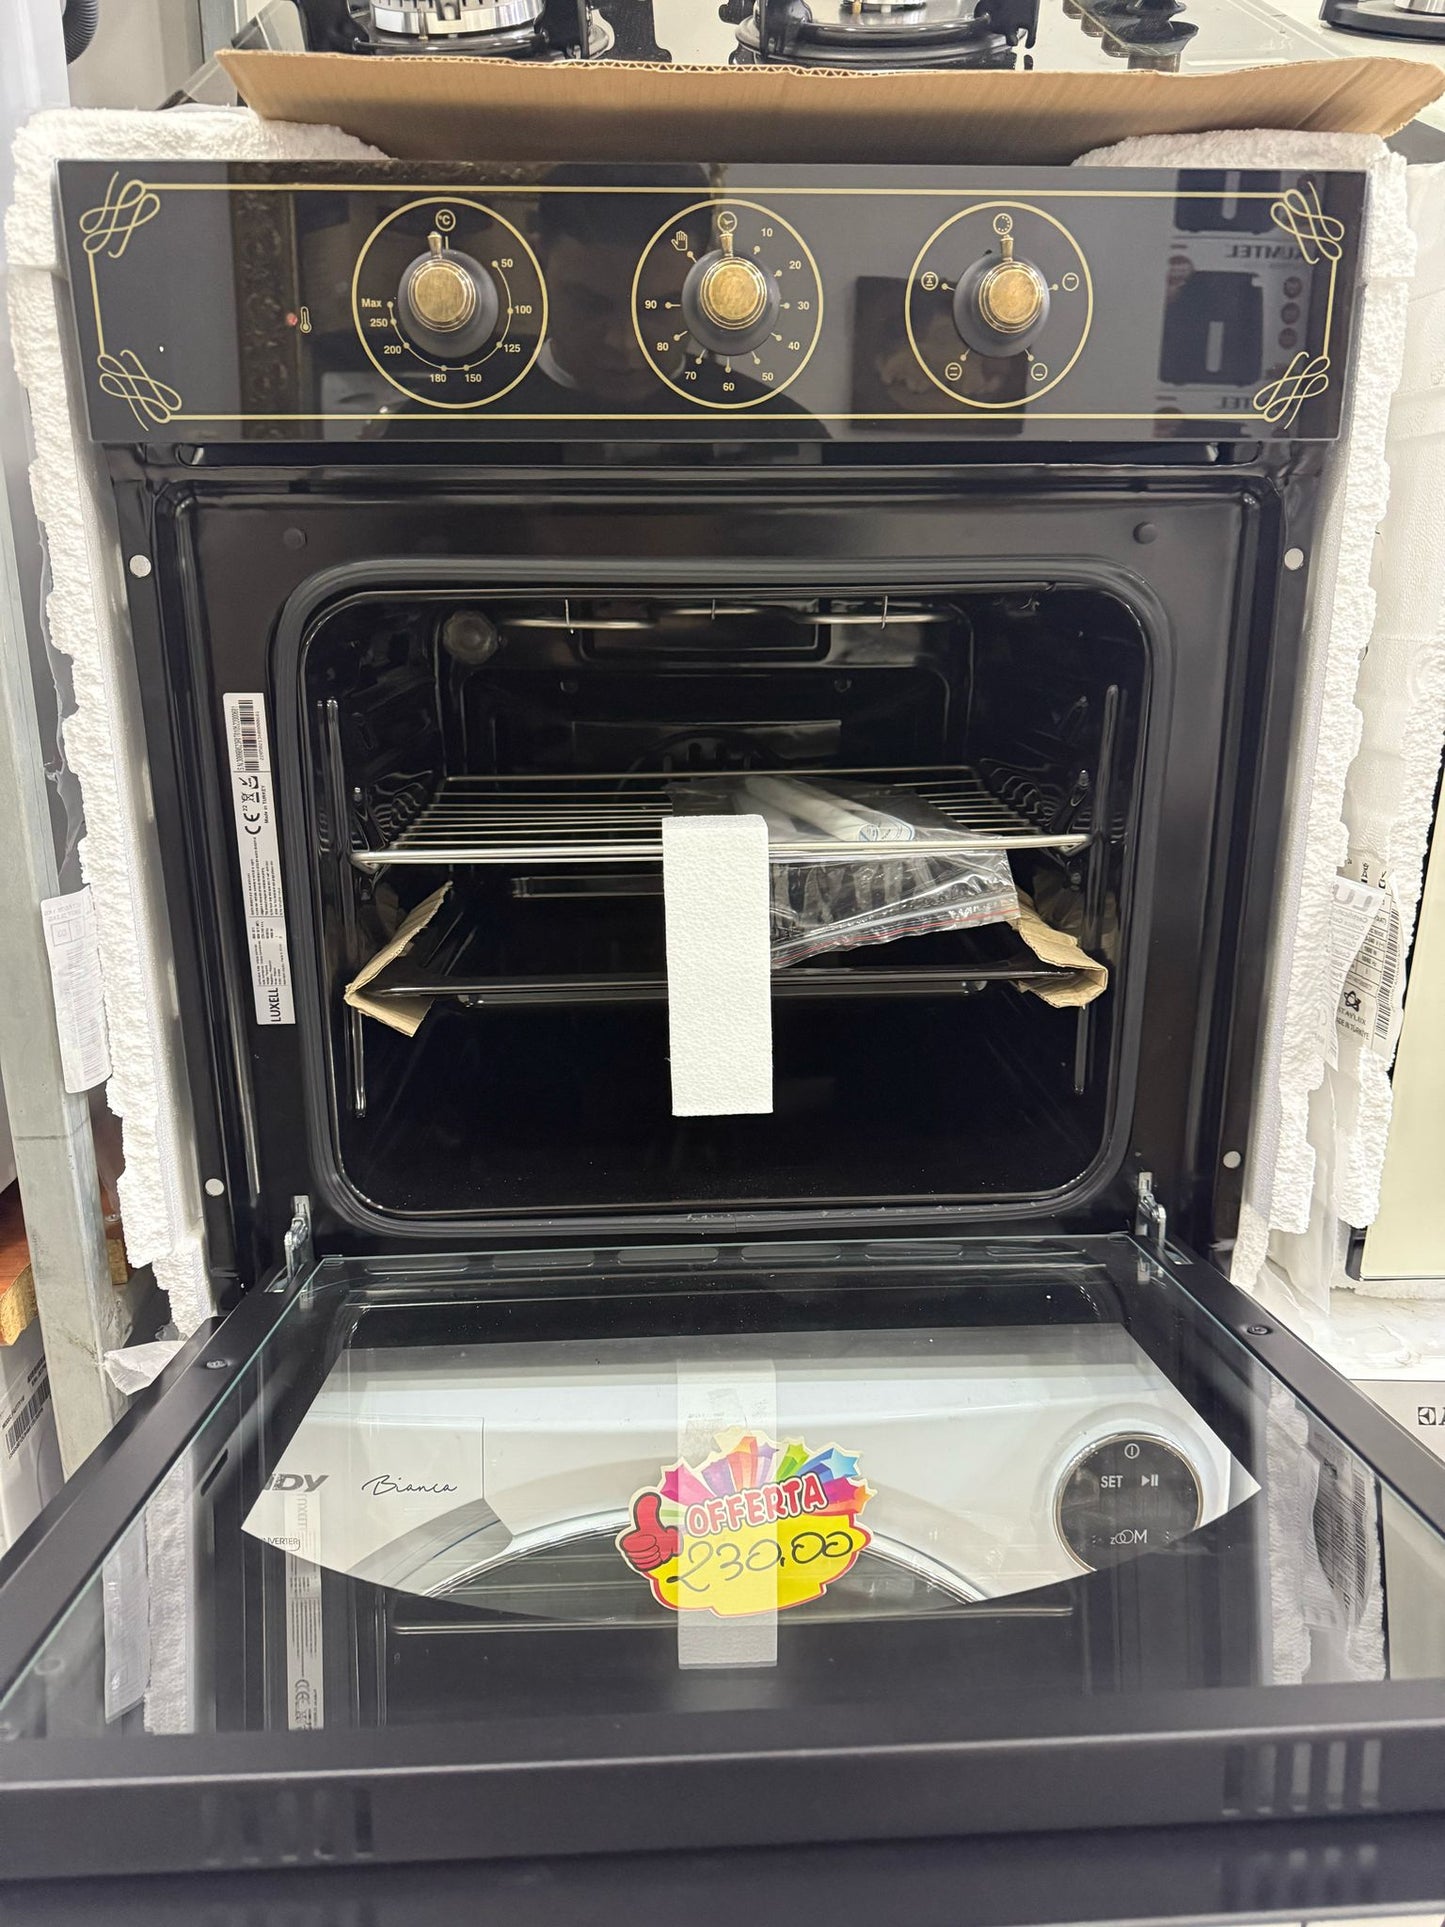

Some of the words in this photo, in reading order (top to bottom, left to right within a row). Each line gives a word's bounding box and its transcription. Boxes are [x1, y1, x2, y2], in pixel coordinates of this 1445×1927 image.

[438, 215, 451, 226] °C
[761, 228, 773, 237] 10
[501, 259, 513, 268] 50
[789, 261, 801, 270] 20
[361, 299, 382, 308] Max
[645, 300, 657, 309] 90
[797, 301, 809, 310] 30
[515, 306, 532, 315] 100
[370, 319, 388, 328] 250
[384, 346, 401, 354] 200
[504, 344, 521, 353] 125
[657, 342, 669, 351] 80
[788, 342, 800, 351] 40
[430, 374, 447, 383] 180
[465, 374, 482, 383] 150
[685, 372, 697, 381] 70
[762, 372, 774, 381] 50
[723, 382, 735, 391] 60
[268, 987, 282, 1022] LUXELL
[361, 1474, 458, 1496] Bianca
[1100, 1475, 1123, 1488] SET
[685, 1471, 828, 1538] OFFERTA
[666, 1531, 854, 1592] 230,00
